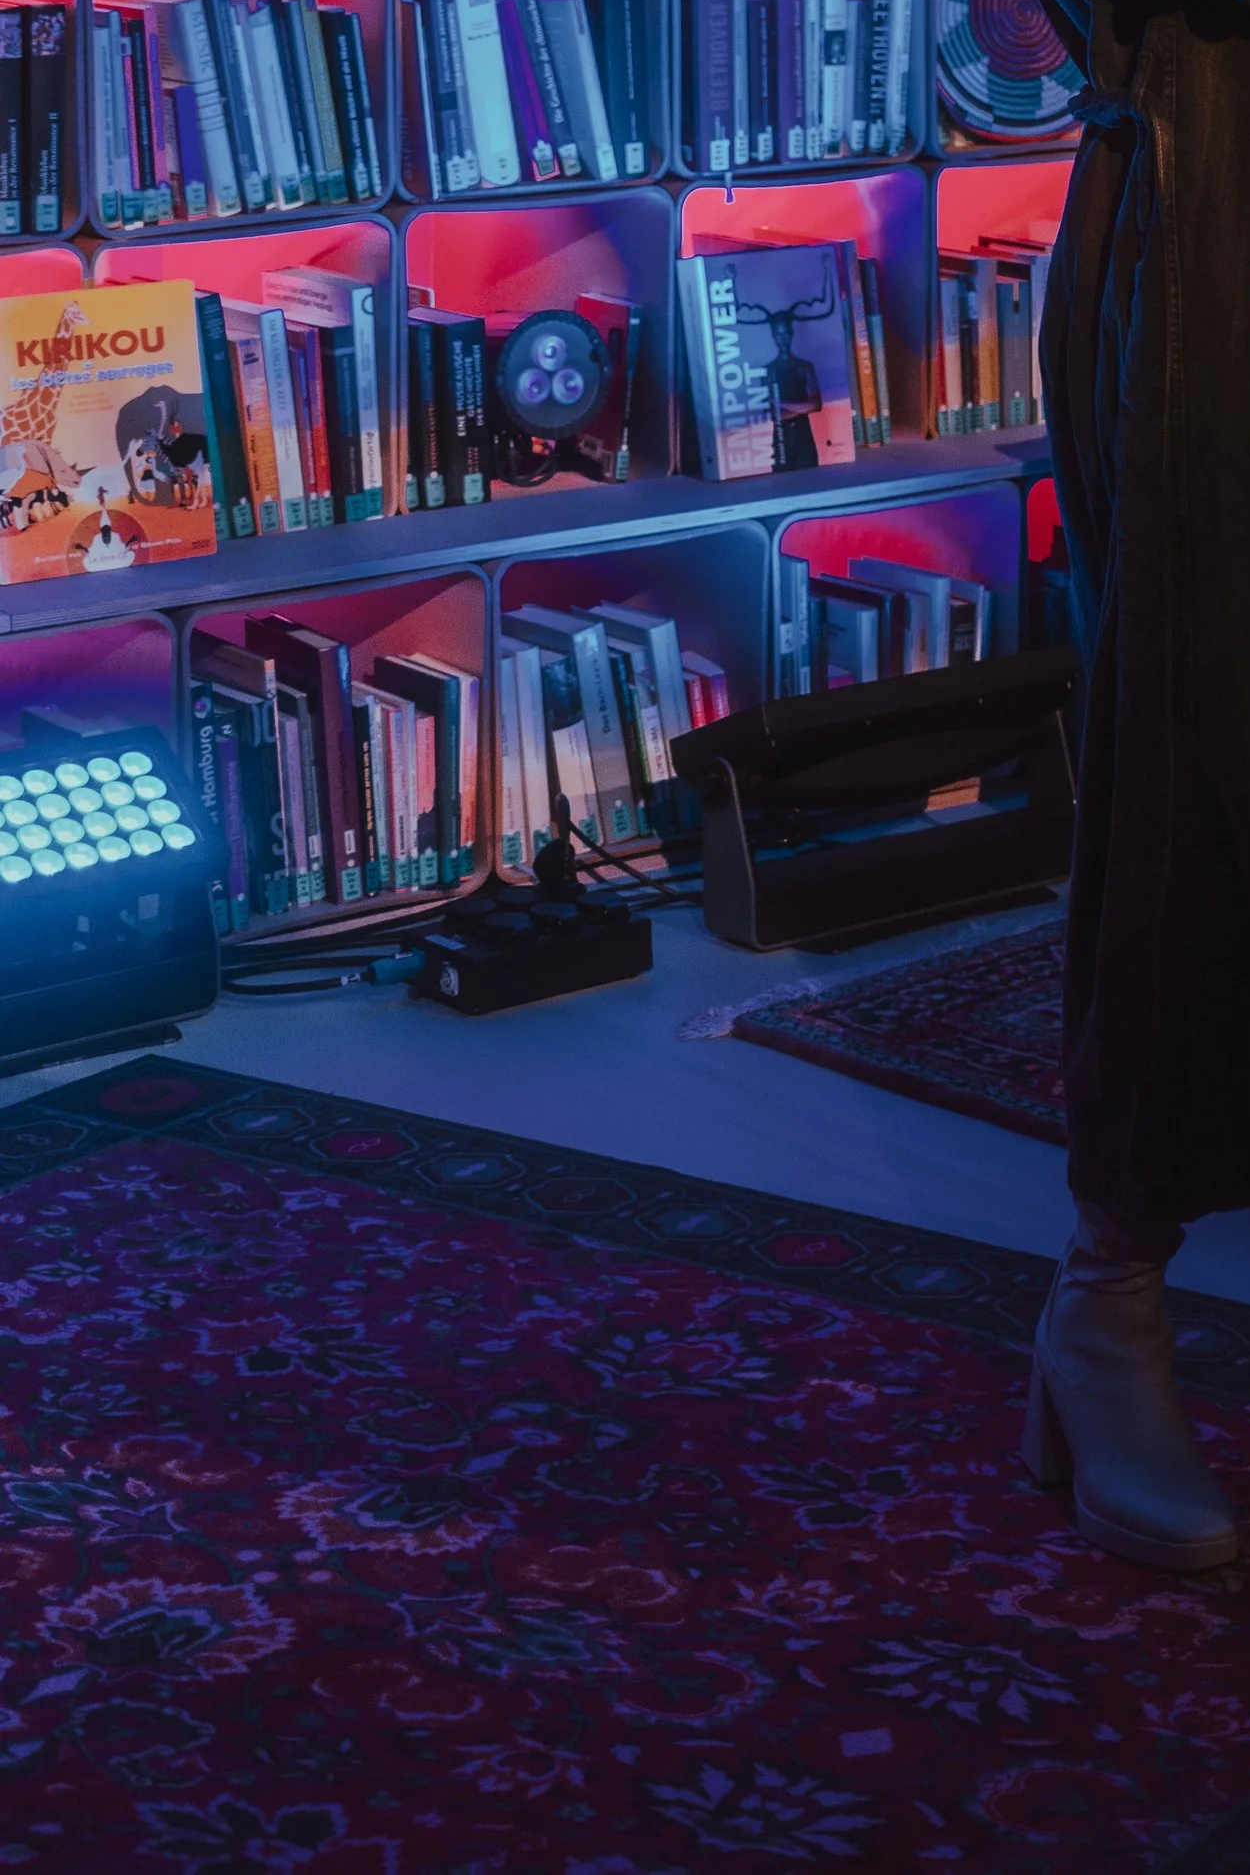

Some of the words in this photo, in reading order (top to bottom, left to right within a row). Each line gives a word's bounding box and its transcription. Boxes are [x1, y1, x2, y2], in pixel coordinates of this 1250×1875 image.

[708, 3, 730, 111] BEETHOVEN
[16, 326, 165, 367] KIRIKOU
[452, 340, 465, 411] MUSIKALISCHE
[456, 415, 467, 436] EINE
[198, 725, 217, 807] Hamburg
